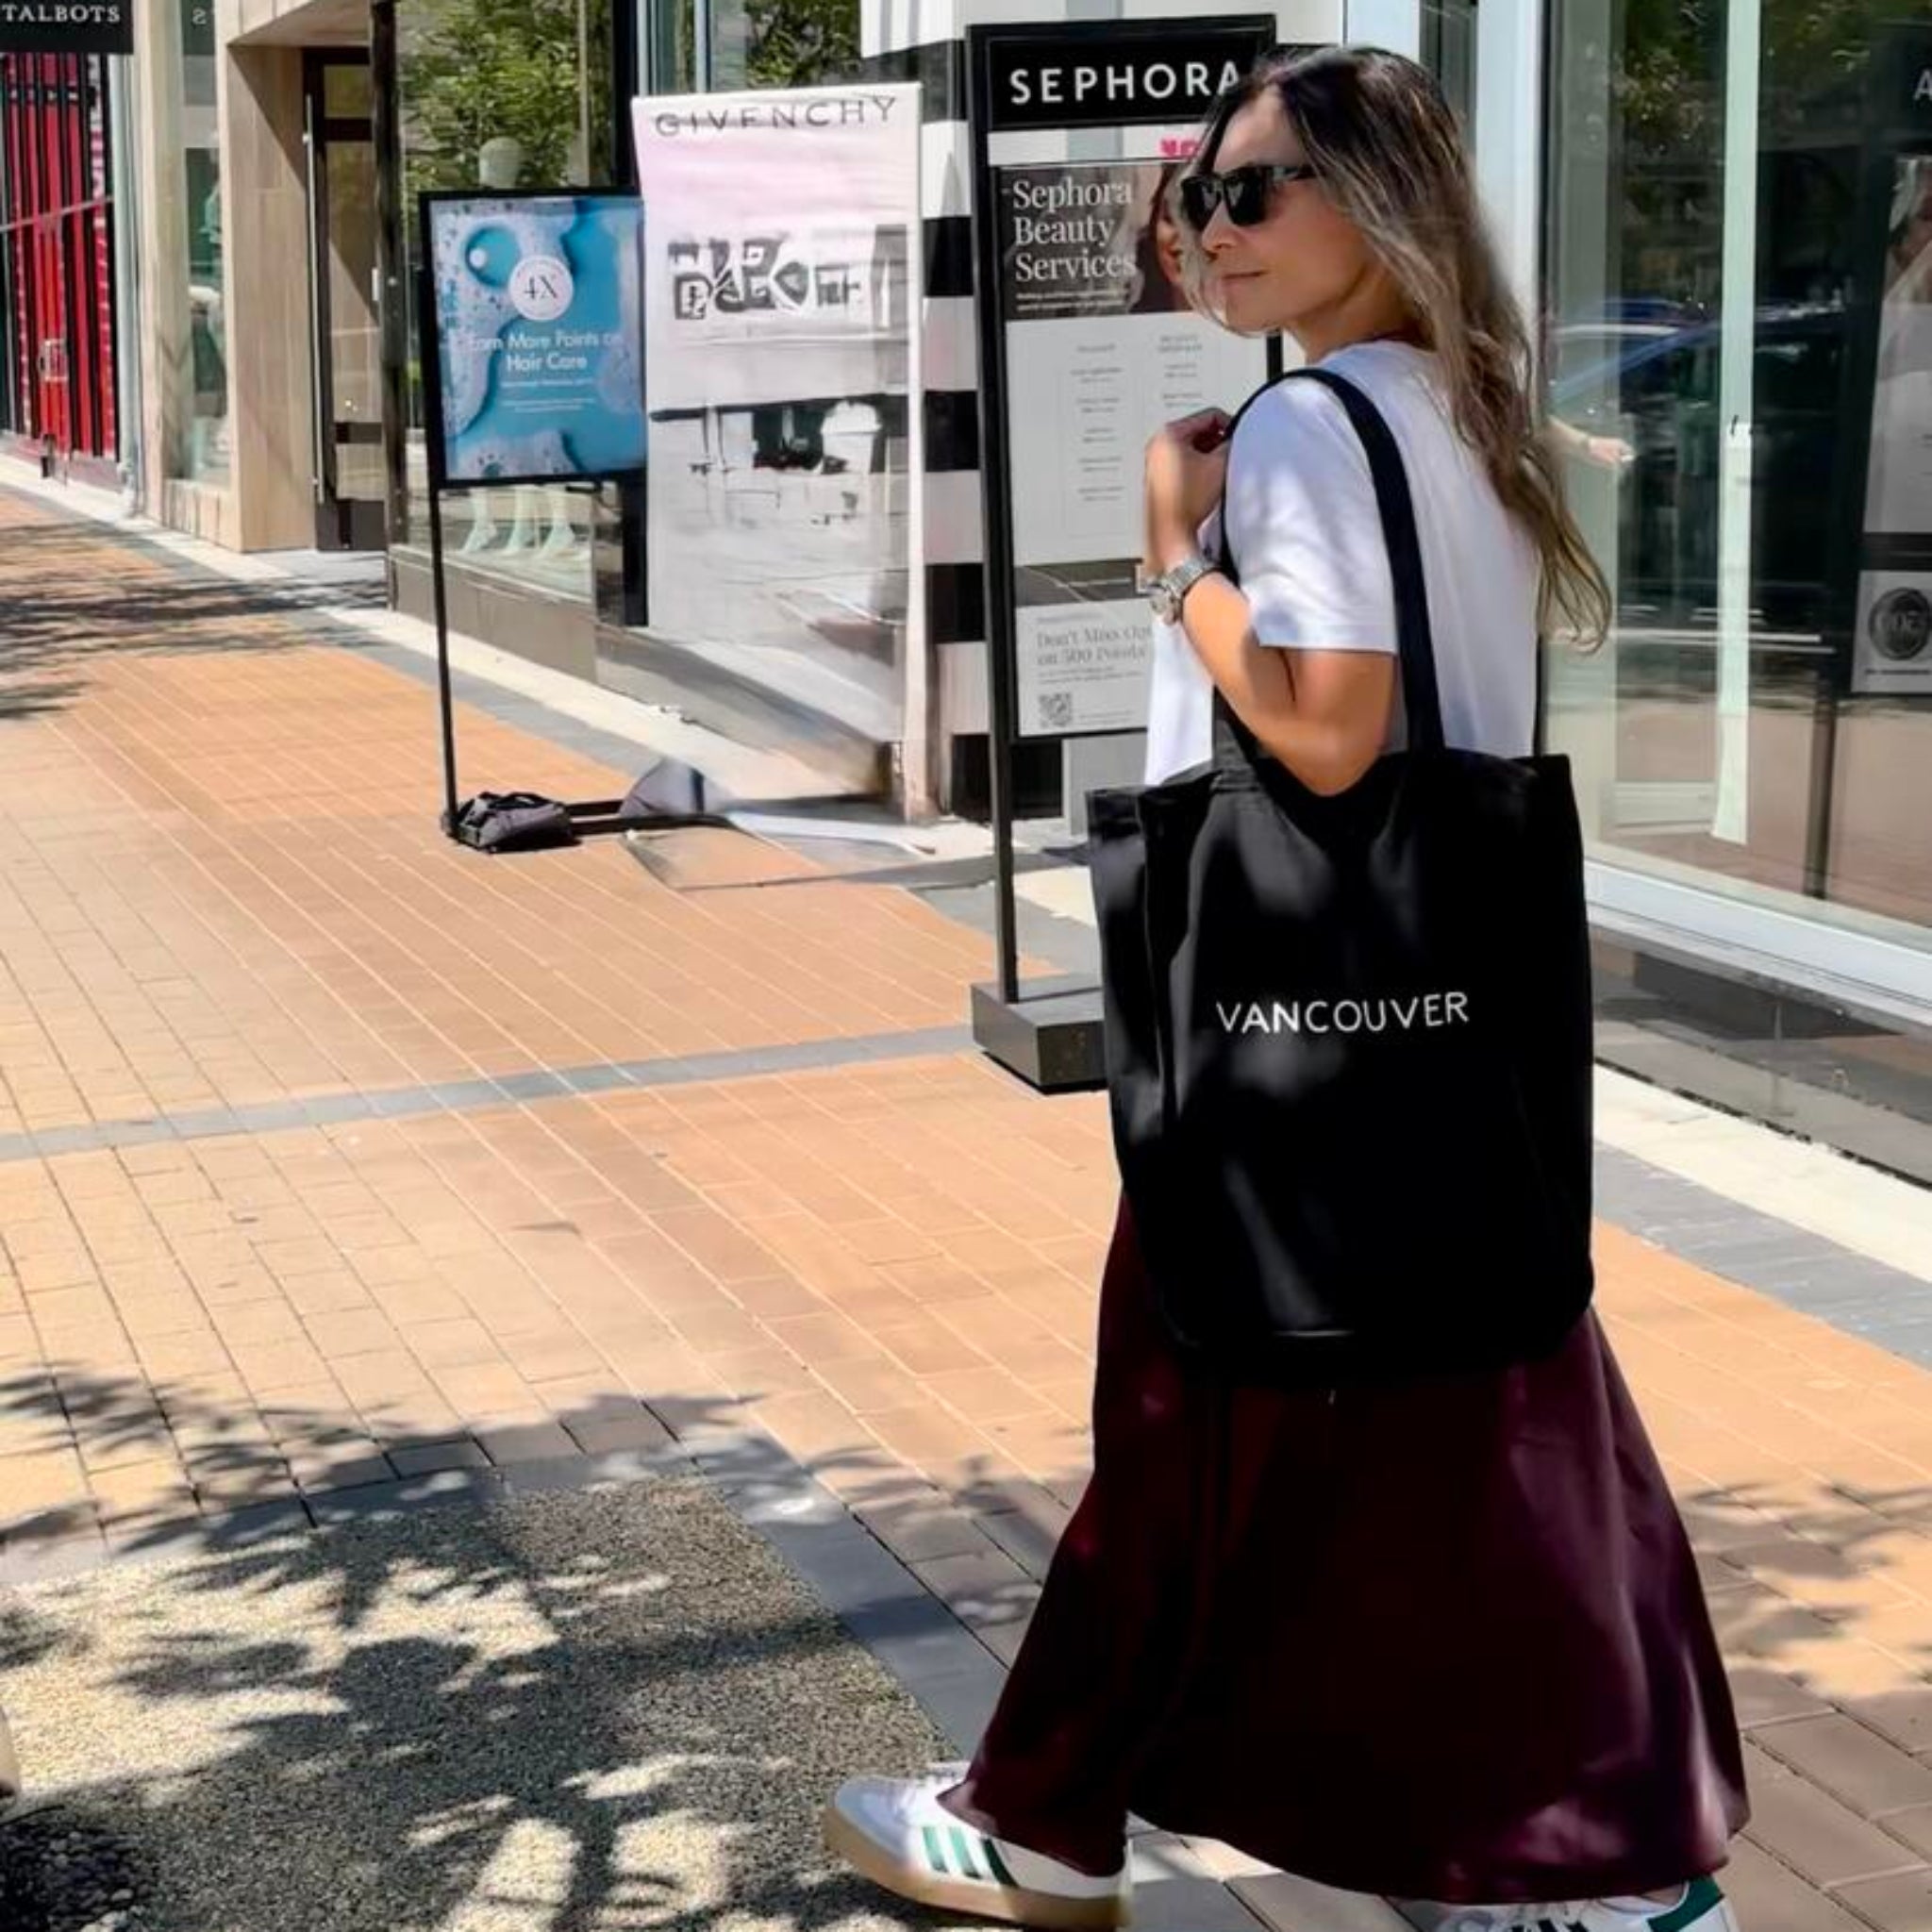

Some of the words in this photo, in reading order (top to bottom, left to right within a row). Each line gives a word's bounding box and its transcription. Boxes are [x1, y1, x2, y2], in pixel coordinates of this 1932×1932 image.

[2, 4, 121, 24] TALBOTS
[1009, 60, 1241, 106] SEPHORA
[655, 95, 895, 137] GIVENCHY
[1012, 176, 1133, 214] Sephora
[1014, 216, 1114, 247] Beauty
[1014, 249, 1139, 282] Services
[523, 274, 560, 300] 4X
[508, 331, 550, 350] More
[506, 352, 544, 371] Hair
[546, 352, 589, 371] Care
[1216, 991, 1469, 1034] VANCOUVER
